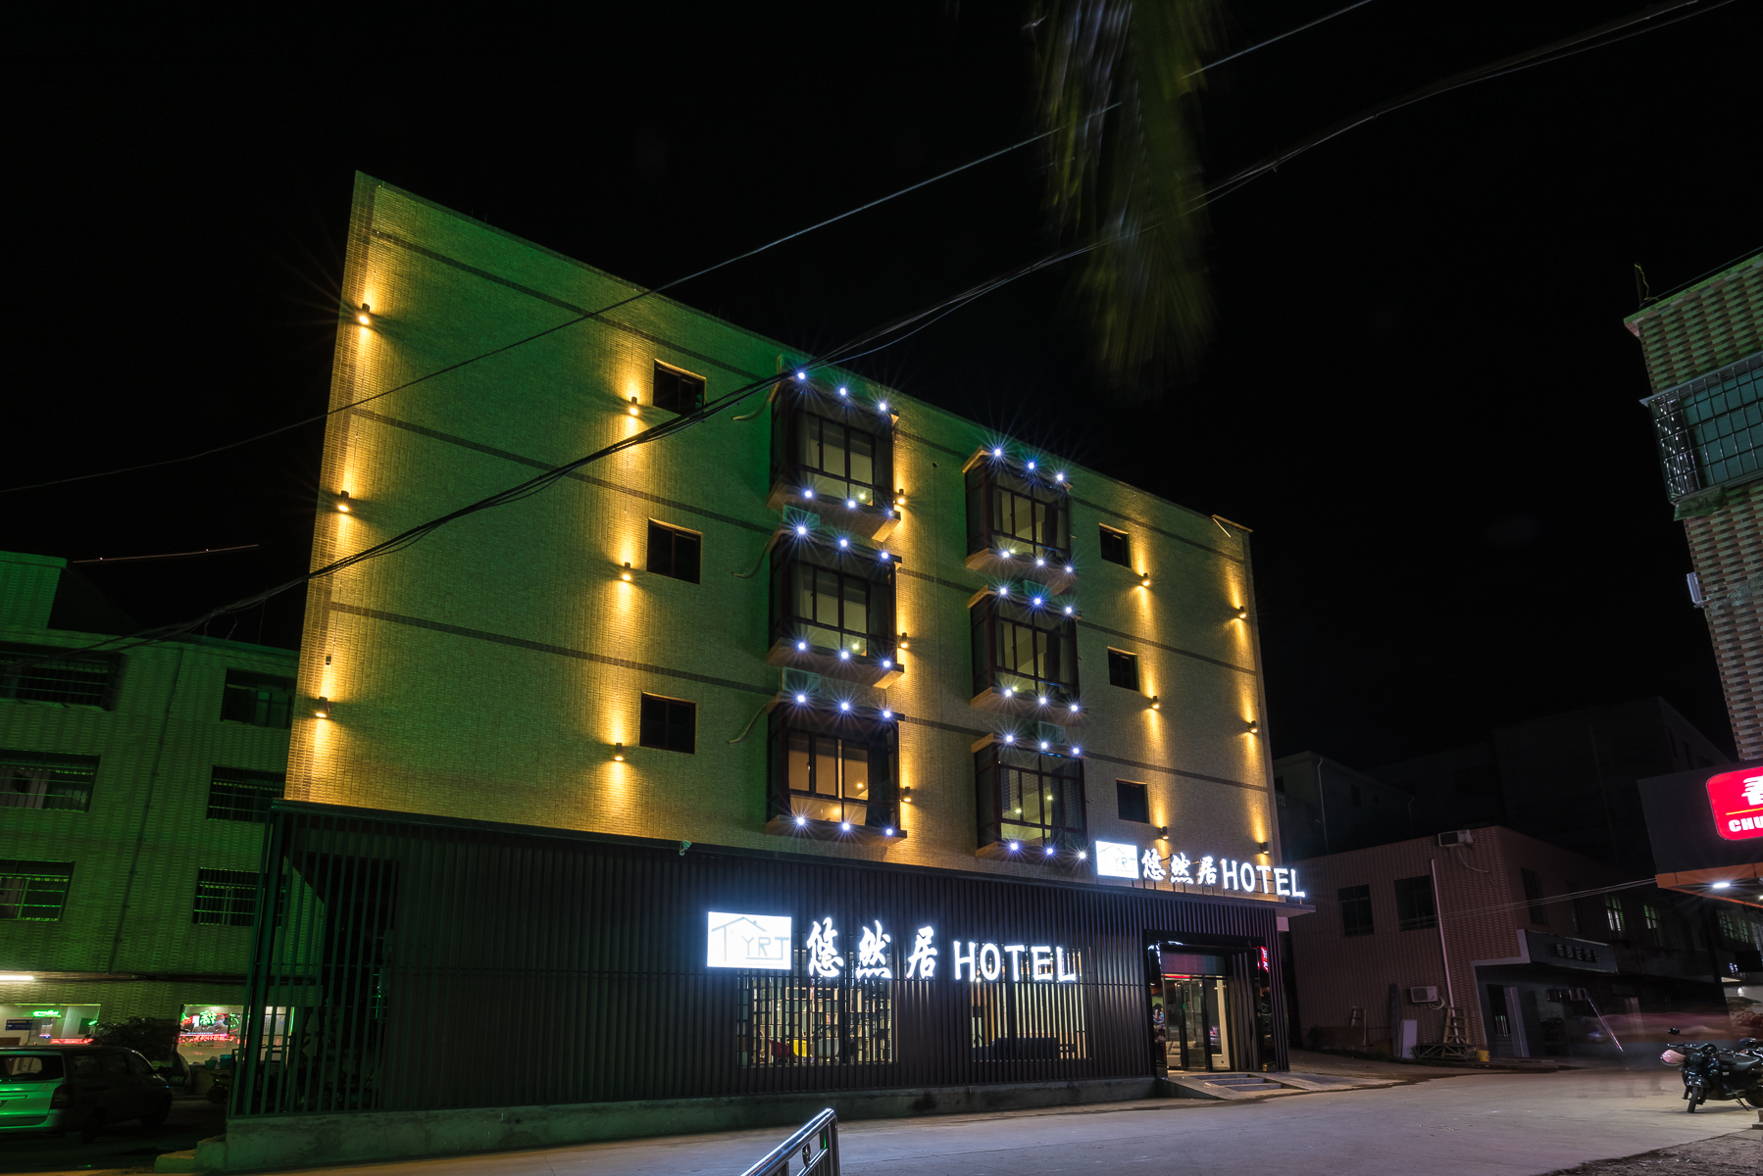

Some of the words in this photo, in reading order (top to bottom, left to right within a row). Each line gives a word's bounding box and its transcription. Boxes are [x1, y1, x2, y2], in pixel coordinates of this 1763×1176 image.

[1141, 847, 1218, 886] 悠然居
[1220, 857, 1306, 898] HOTEL
[806, 916, 939, 980] 悠然居
[953, 939, 1077, 982] HOTEL
